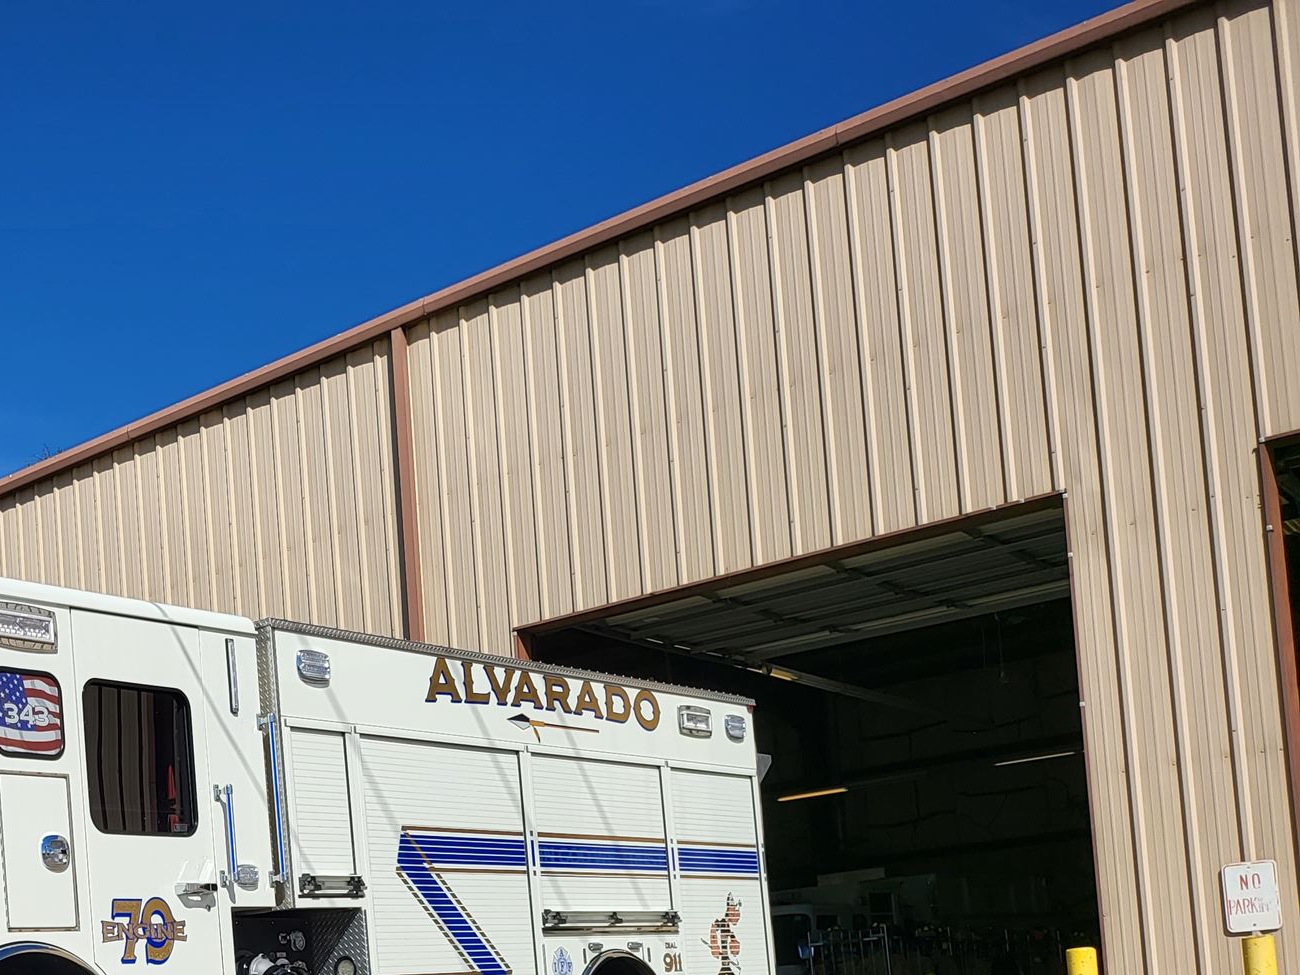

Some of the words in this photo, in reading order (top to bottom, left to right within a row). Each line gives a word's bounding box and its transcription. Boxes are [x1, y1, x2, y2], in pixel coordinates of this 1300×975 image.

[425, 657, 661, 731] ALVARADO
[3, 702, 49, 727] 343
[1239, 873, 1261, 891] NO
[101, 920, 187, 943] ENGINE
[111, 896, 175, 965] 79
[663, 952, 683, 972] 911
